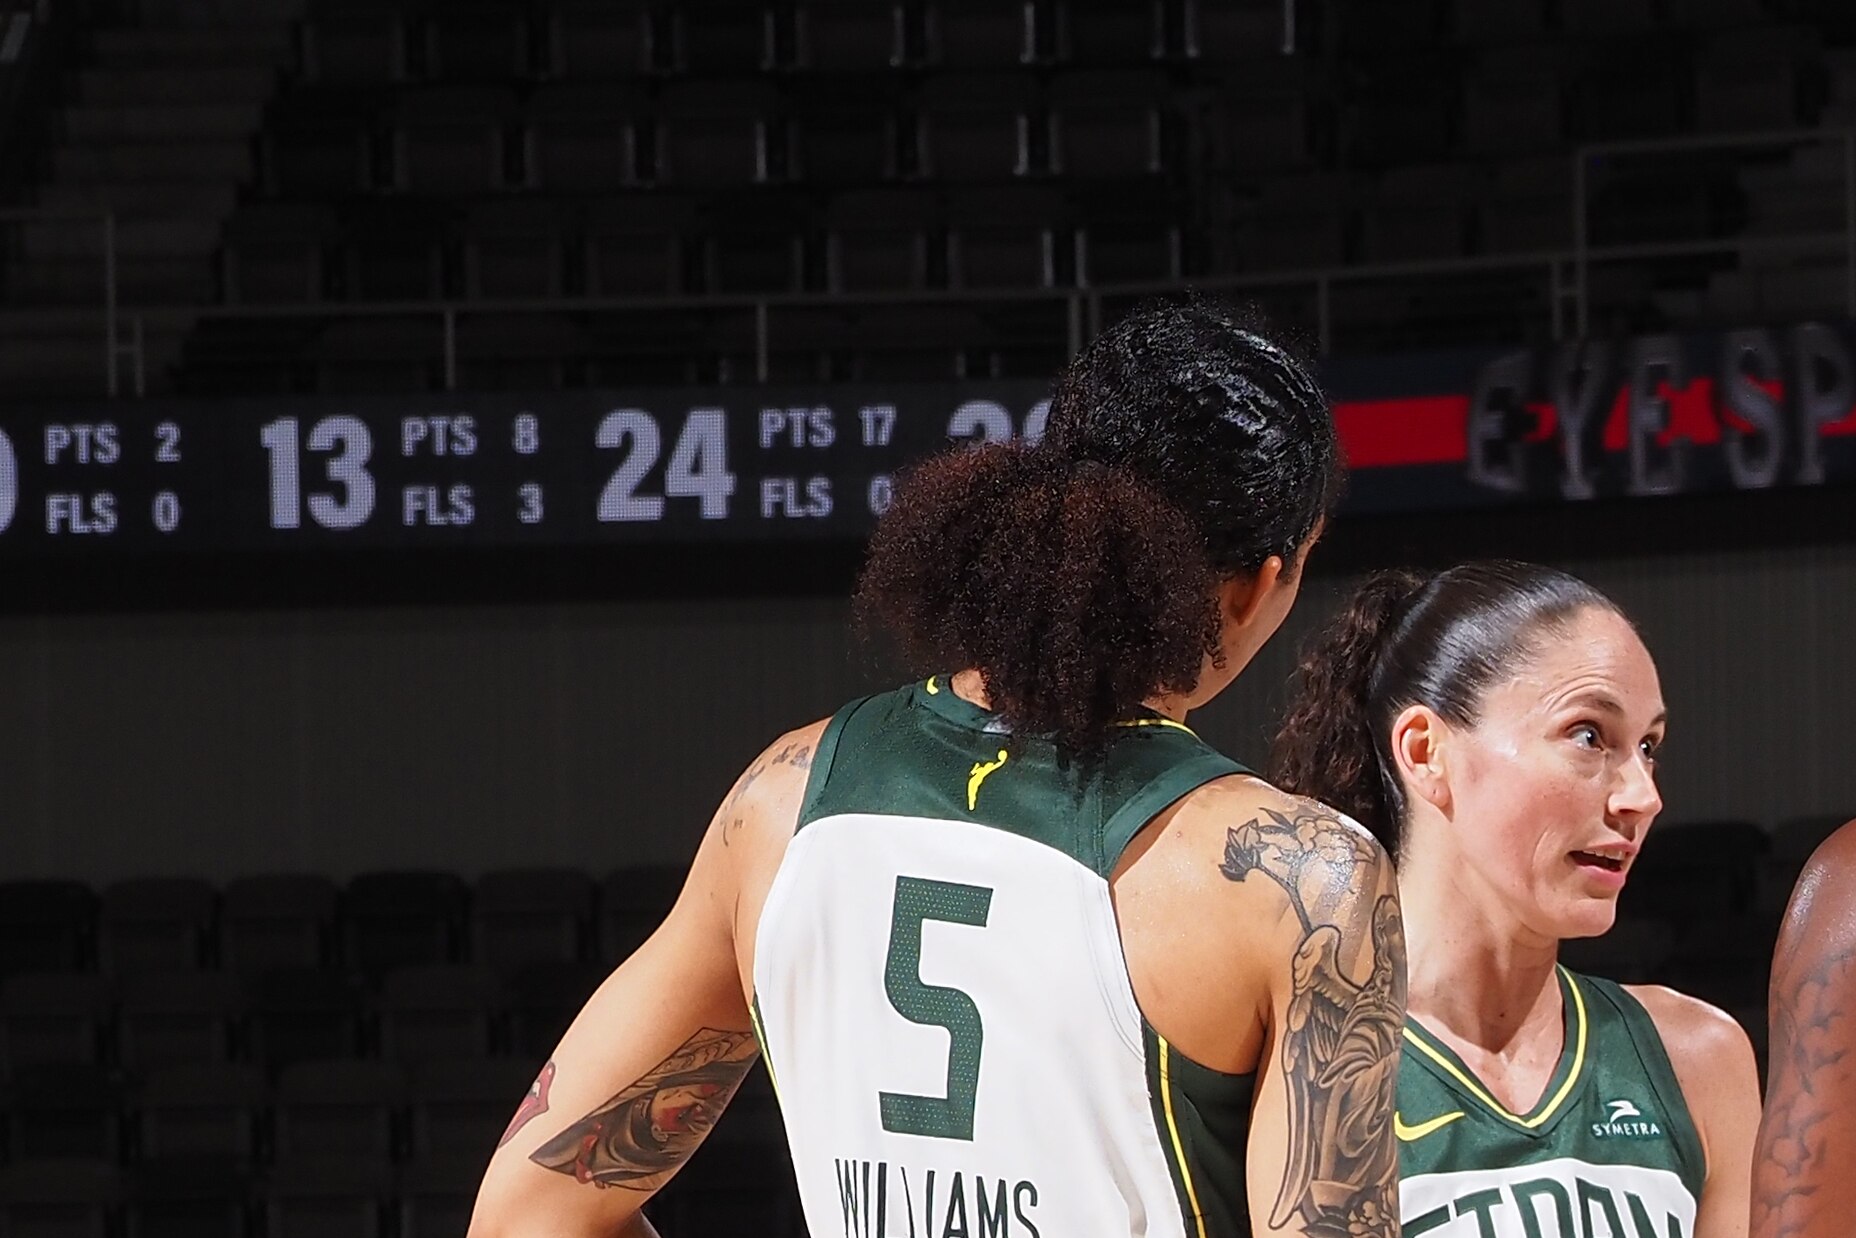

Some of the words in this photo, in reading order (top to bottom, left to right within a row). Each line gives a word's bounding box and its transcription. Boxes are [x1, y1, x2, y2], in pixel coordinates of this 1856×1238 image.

[401, 416, 477, 456] PTS
[513, 414, 539, 454] 8
[758, 406, 836, 448] PTS
[858, 404, 897, 446] 17
[1466, 334, 1688, 501] EYE
[44, 423, 121, 465] PTS
[154, 421, 182, 463] 2
[594, 408, 737, 522] 24
[260, 415, 376, 529] 13
[45, 492, 119, 534] FLS
[153, 491, 182, 532] 0
[402, 484, 476, 526] FLS
[517, 484, 544, 523] 3
[759, 473, 834, 518] FLS
[878, 875, 994, 1142] 5
[1592, 1122, 1661, 1137] SYMETRA
